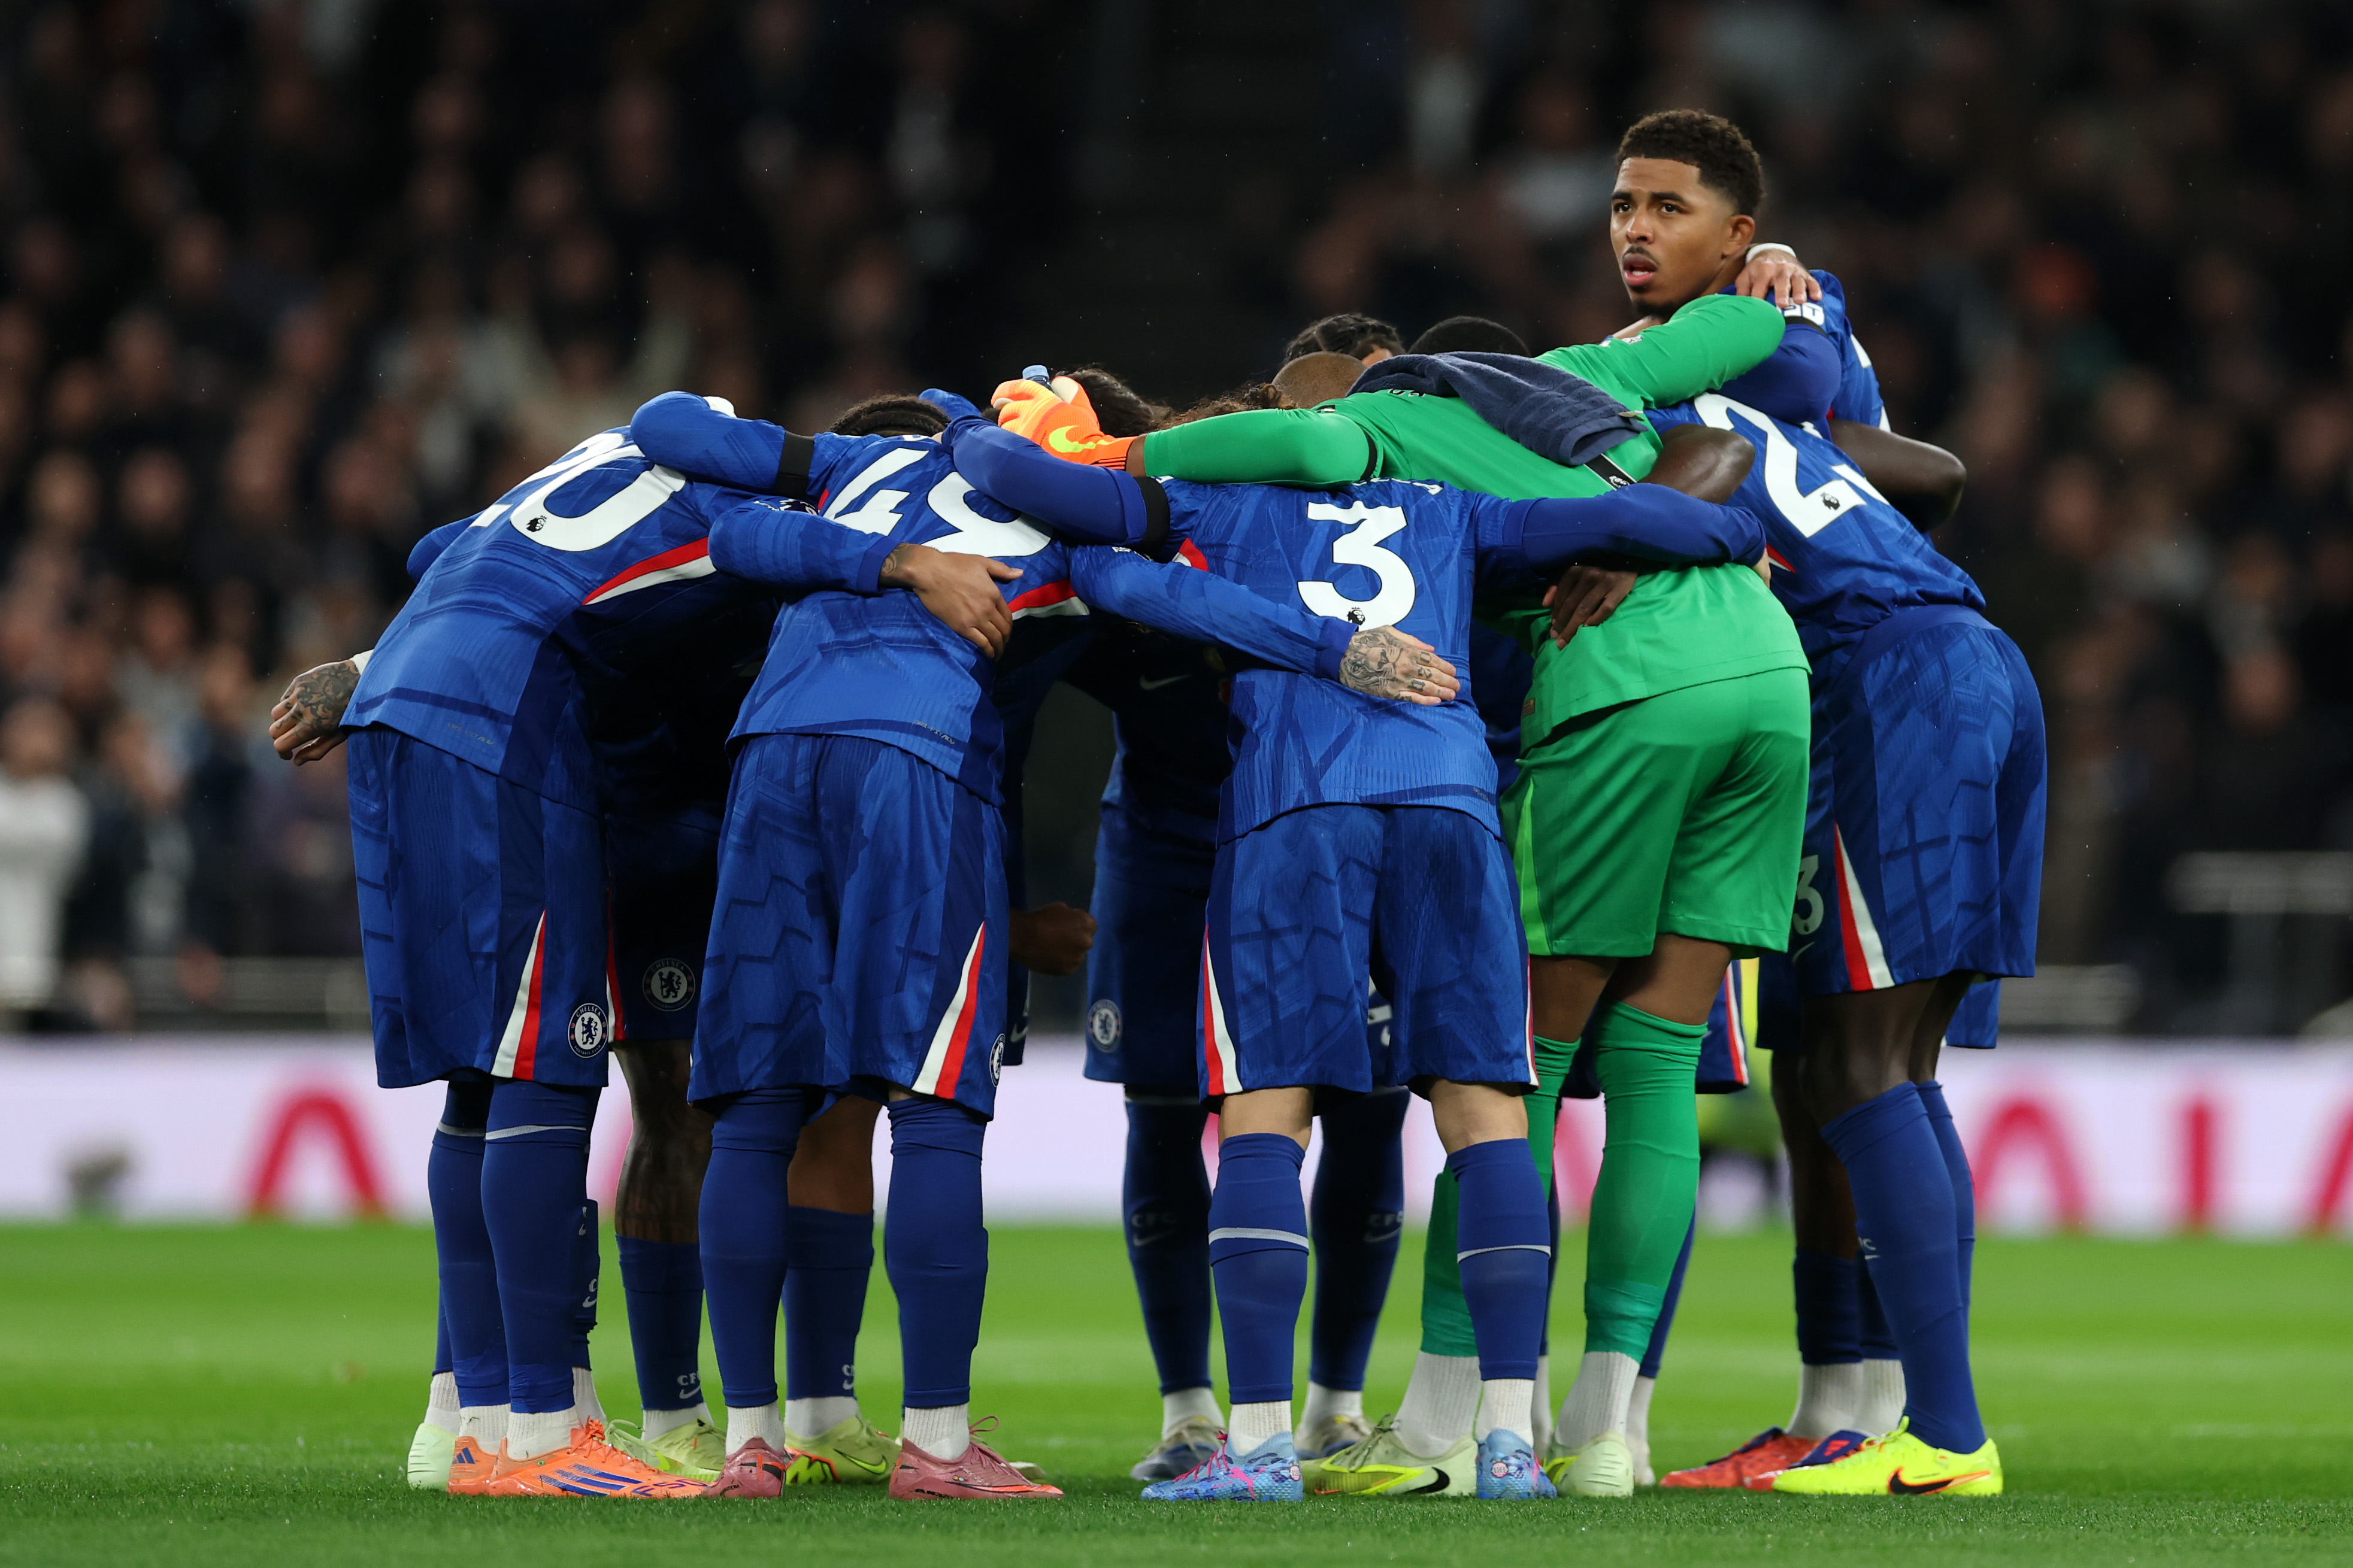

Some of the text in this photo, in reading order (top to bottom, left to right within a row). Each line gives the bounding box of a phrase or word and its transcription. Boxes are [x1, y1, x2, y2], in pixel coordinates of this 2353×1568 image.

[471, 433, 686, 551] 20
[1298, 501, 1416, 632] 3
[576, 1006, 601, 1017] CHELSEA
